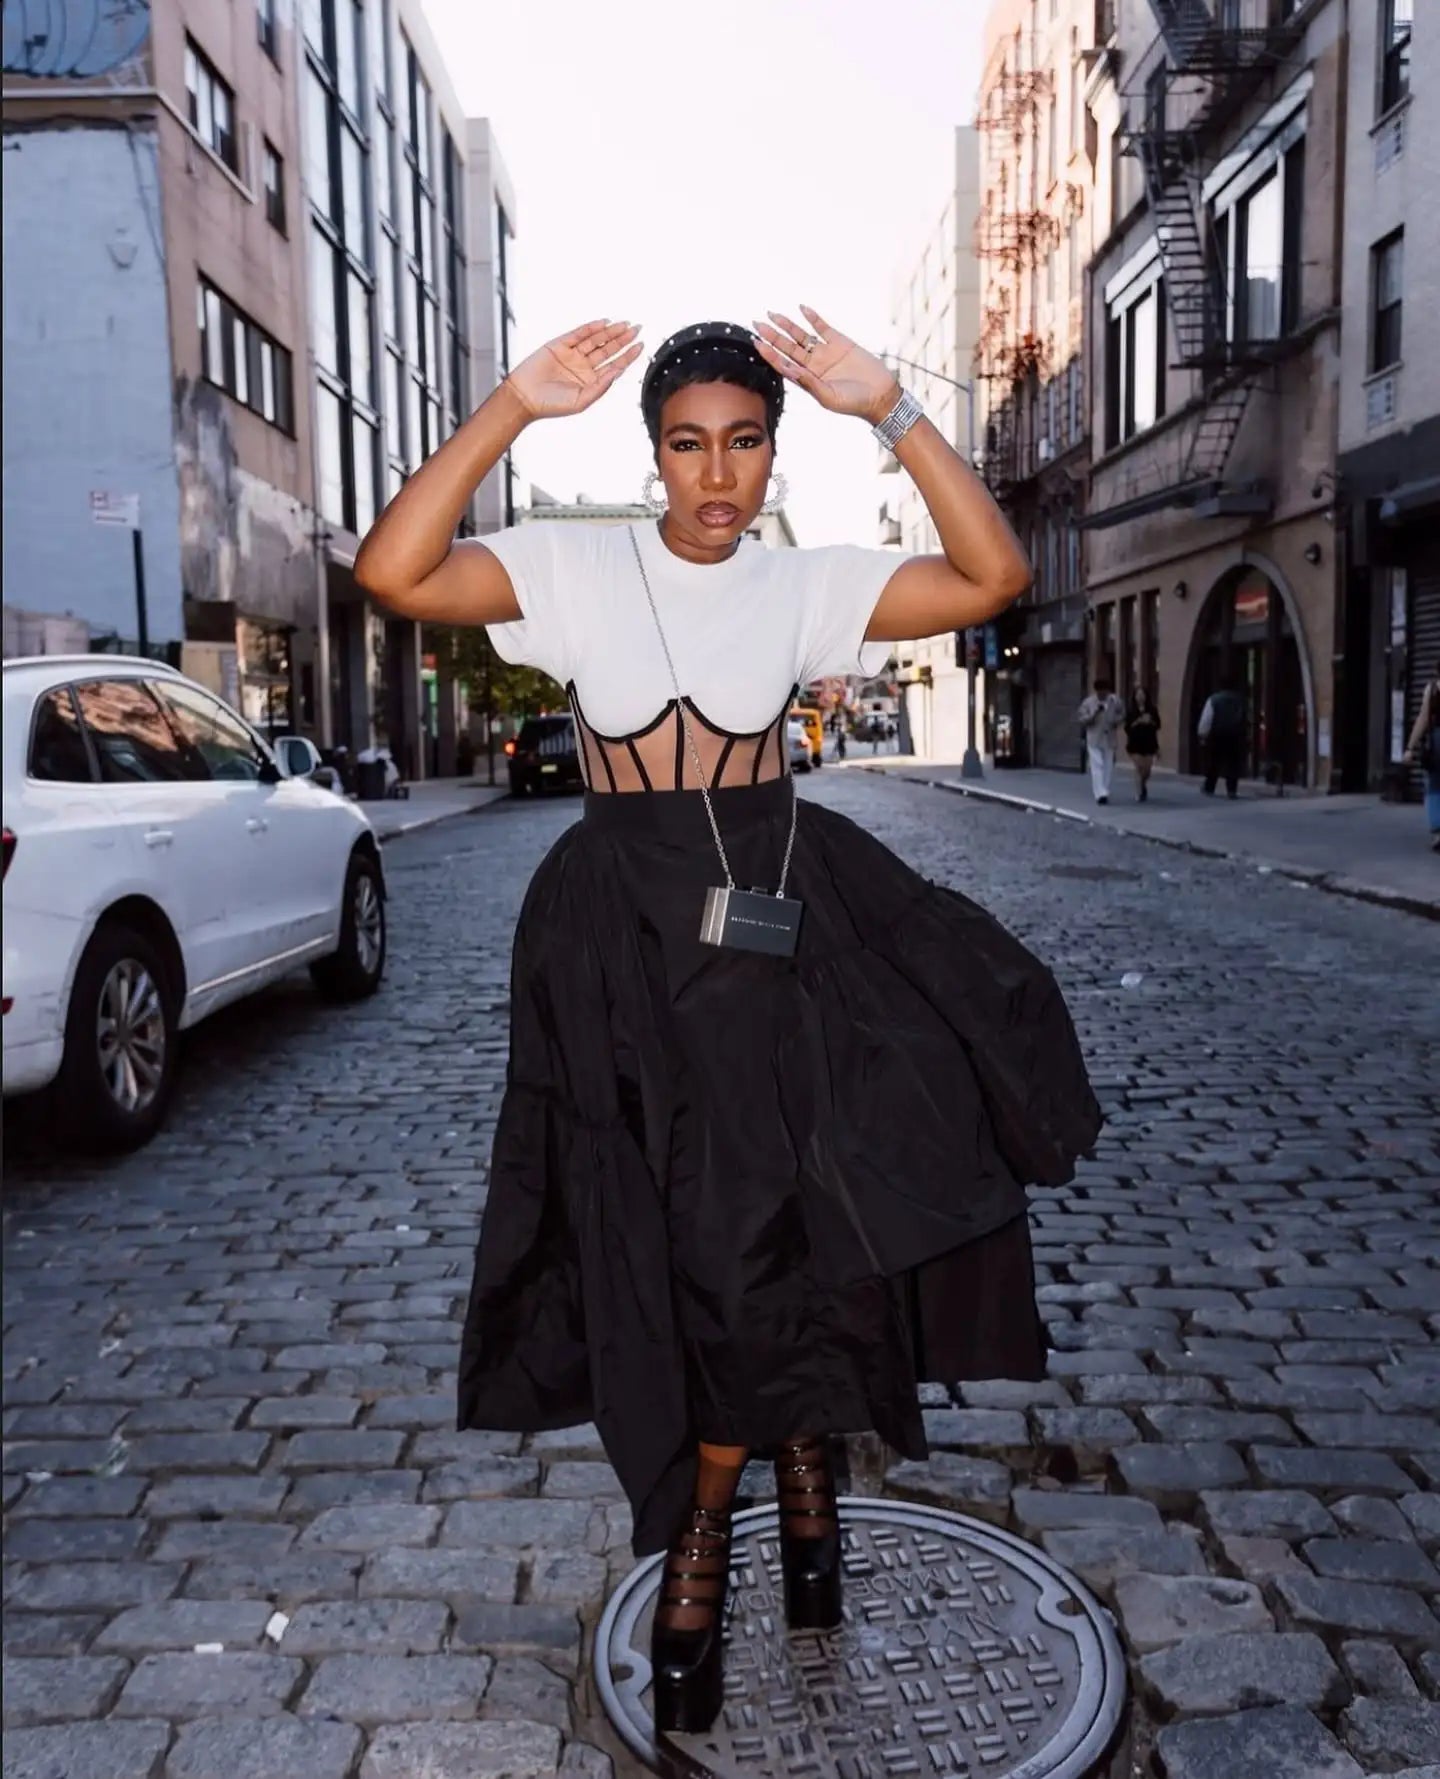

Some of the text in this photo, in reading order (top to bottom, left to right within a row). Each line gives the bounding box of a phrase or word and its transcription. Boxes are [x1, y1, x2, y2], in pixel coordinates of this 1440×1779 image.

[724, 1567, 942, 1613] MADE NDIA
[726, 1611, 1000, 1671] NYC SEWE
